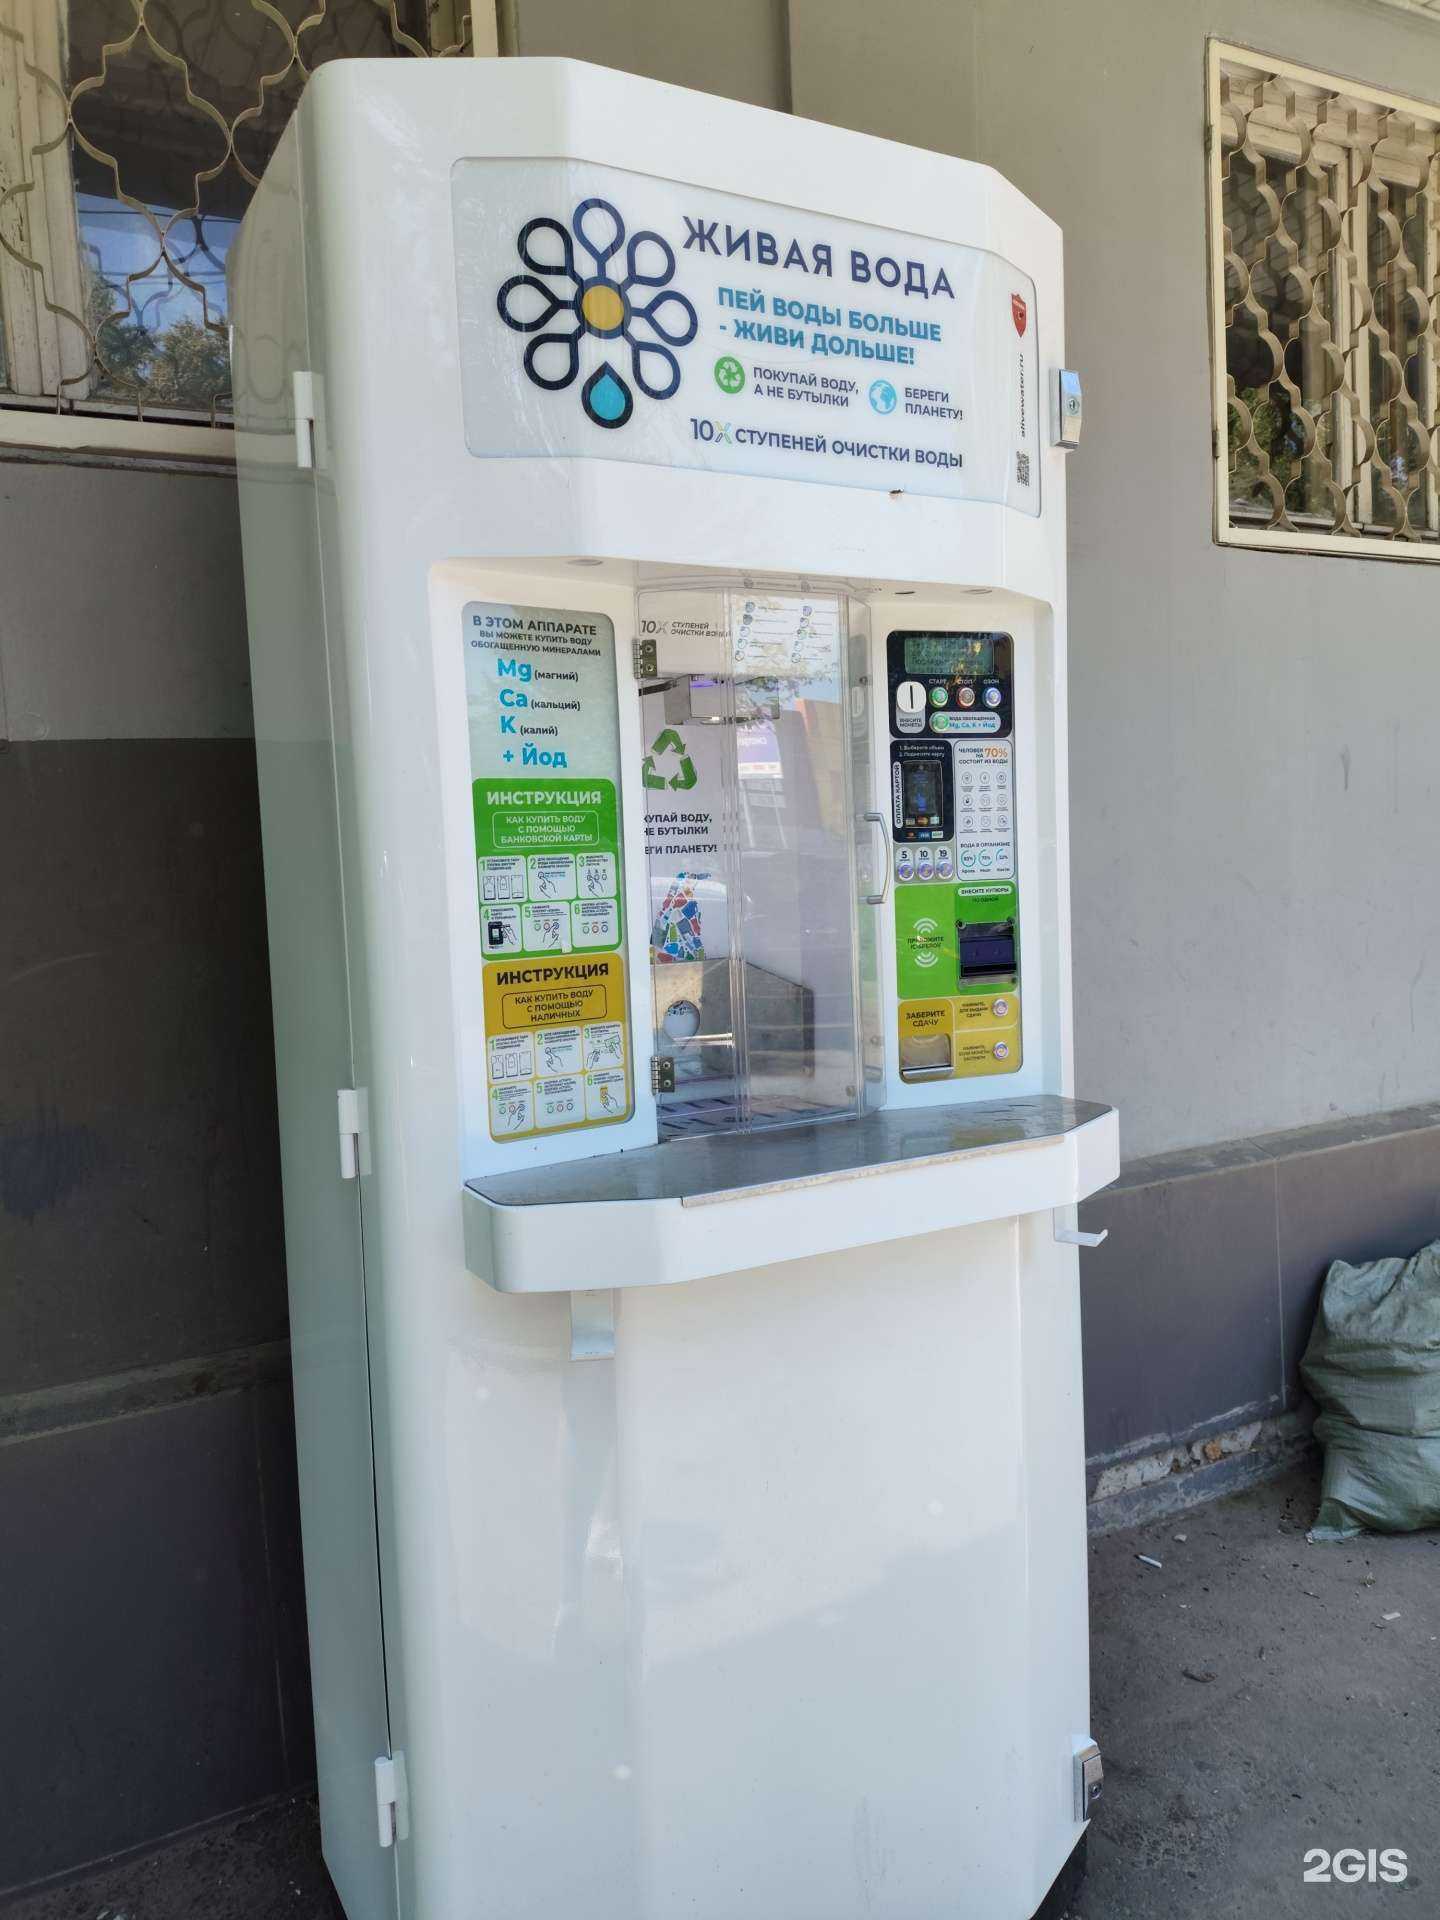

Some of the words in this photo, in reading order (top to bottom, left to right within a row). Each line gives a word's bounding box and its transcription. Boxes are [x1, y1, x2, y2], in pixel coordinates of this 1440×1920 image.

[682, 215, 833, 278] ЖИВАЯ
[850, 249, 955, 300] ВОДА
[718, 286, 766, 314] ПЕЙ
[772, 297, 842, 327] ВОДЫ
[848, 310, 942, 342] БОЛЬШЕ
[733, 318, 805, 349] ЖИВИ
[811, 333, 915, 365] ДОЛЬШЕ!
[753, 366, 817, 387] ПОКУПАЙ
[821, 377, 859, 395] ВОДУ,
[754, 384, 764, 396] А
[766, 385, 784, 399] НЕ
[787, 388, 849, 407] БУТЫЛКИ
[904, 387, 950, 403] БЕРЕГИ
[905, 403, 963, 421] ПЛАНЕТУ!
[735, 428, 827, 453] СТУПЕНЕЙ
[831, 440, 910, 463] ОЧИСТКИ
[914, 449, 963, 469] ВОДЫ
[472, 615, 482, 626] В
[485, 616, 524, 630] ЭТОМ
[527, 620, 597, 636] АППАРАТЕ
[671, 621, 709, 630] СТУПЕНЕЙ
[480, 630, 494, 639] ВЫ
[496, 632, 533, 641] МОЖЕТЕ
[535, 635, 568, 644] КУПИТЬ
[570, 637, 593, 646] ВОДУ
[471, 640, 540, 653] ОБОГАЩЕННУЮ
[542, 645, 601, 656] МИНЕРАЛАМИ
[497, 658, 532, 682] Mg
[534, 670, 579, 682] (магний)
[499, 688, 528, 708] Ca
[530, 700, 581, 712] (кальций)
[520, 725, 559, 737] (калий)
[522, 743, 568, 768] Йод
[984, 747, 1008, 758] 70%
[487, 791, 602, 806] ИНСТРУКЦИЯ
[506, 815, 525, 824] КАК
[526, 815, 561, 823] КУПИТЬ
[562, 815, 586, 823] ВОДУ
[681, 813, 712, 823] ВОДУ,
[526, 825, 576, 834] ПОМОЩЬЮ
[657, 826, 709, 835] БУТЫЛКИ
[501, 834, 561, 844] БАНКОВСКОЙ
[563, 834, 593, 842] КАРТЫ
[665, 844, 718, 855] ПЛАНЕТУ!
[902, 851, 907, 859] 5
[496, 963, 609, 986] ИНСТРУКЦИЯ
[515, 996, 532, 1005] КАК
[534, 993, 569, 1002] КУПИТЬ
[570, 989, 594, 999] ВОДУ
[527, 1005, 532, 1013] С
[534, 1001, 583, 1011] ПОМОЩЬЮ
[906, 1010, 945, 1019] ЗАБЕРИТЕ
[531, 1009, 581, 1022] НАЛИЧНЫХ
[912, 1019, 939, 1027] СДАЧУ
